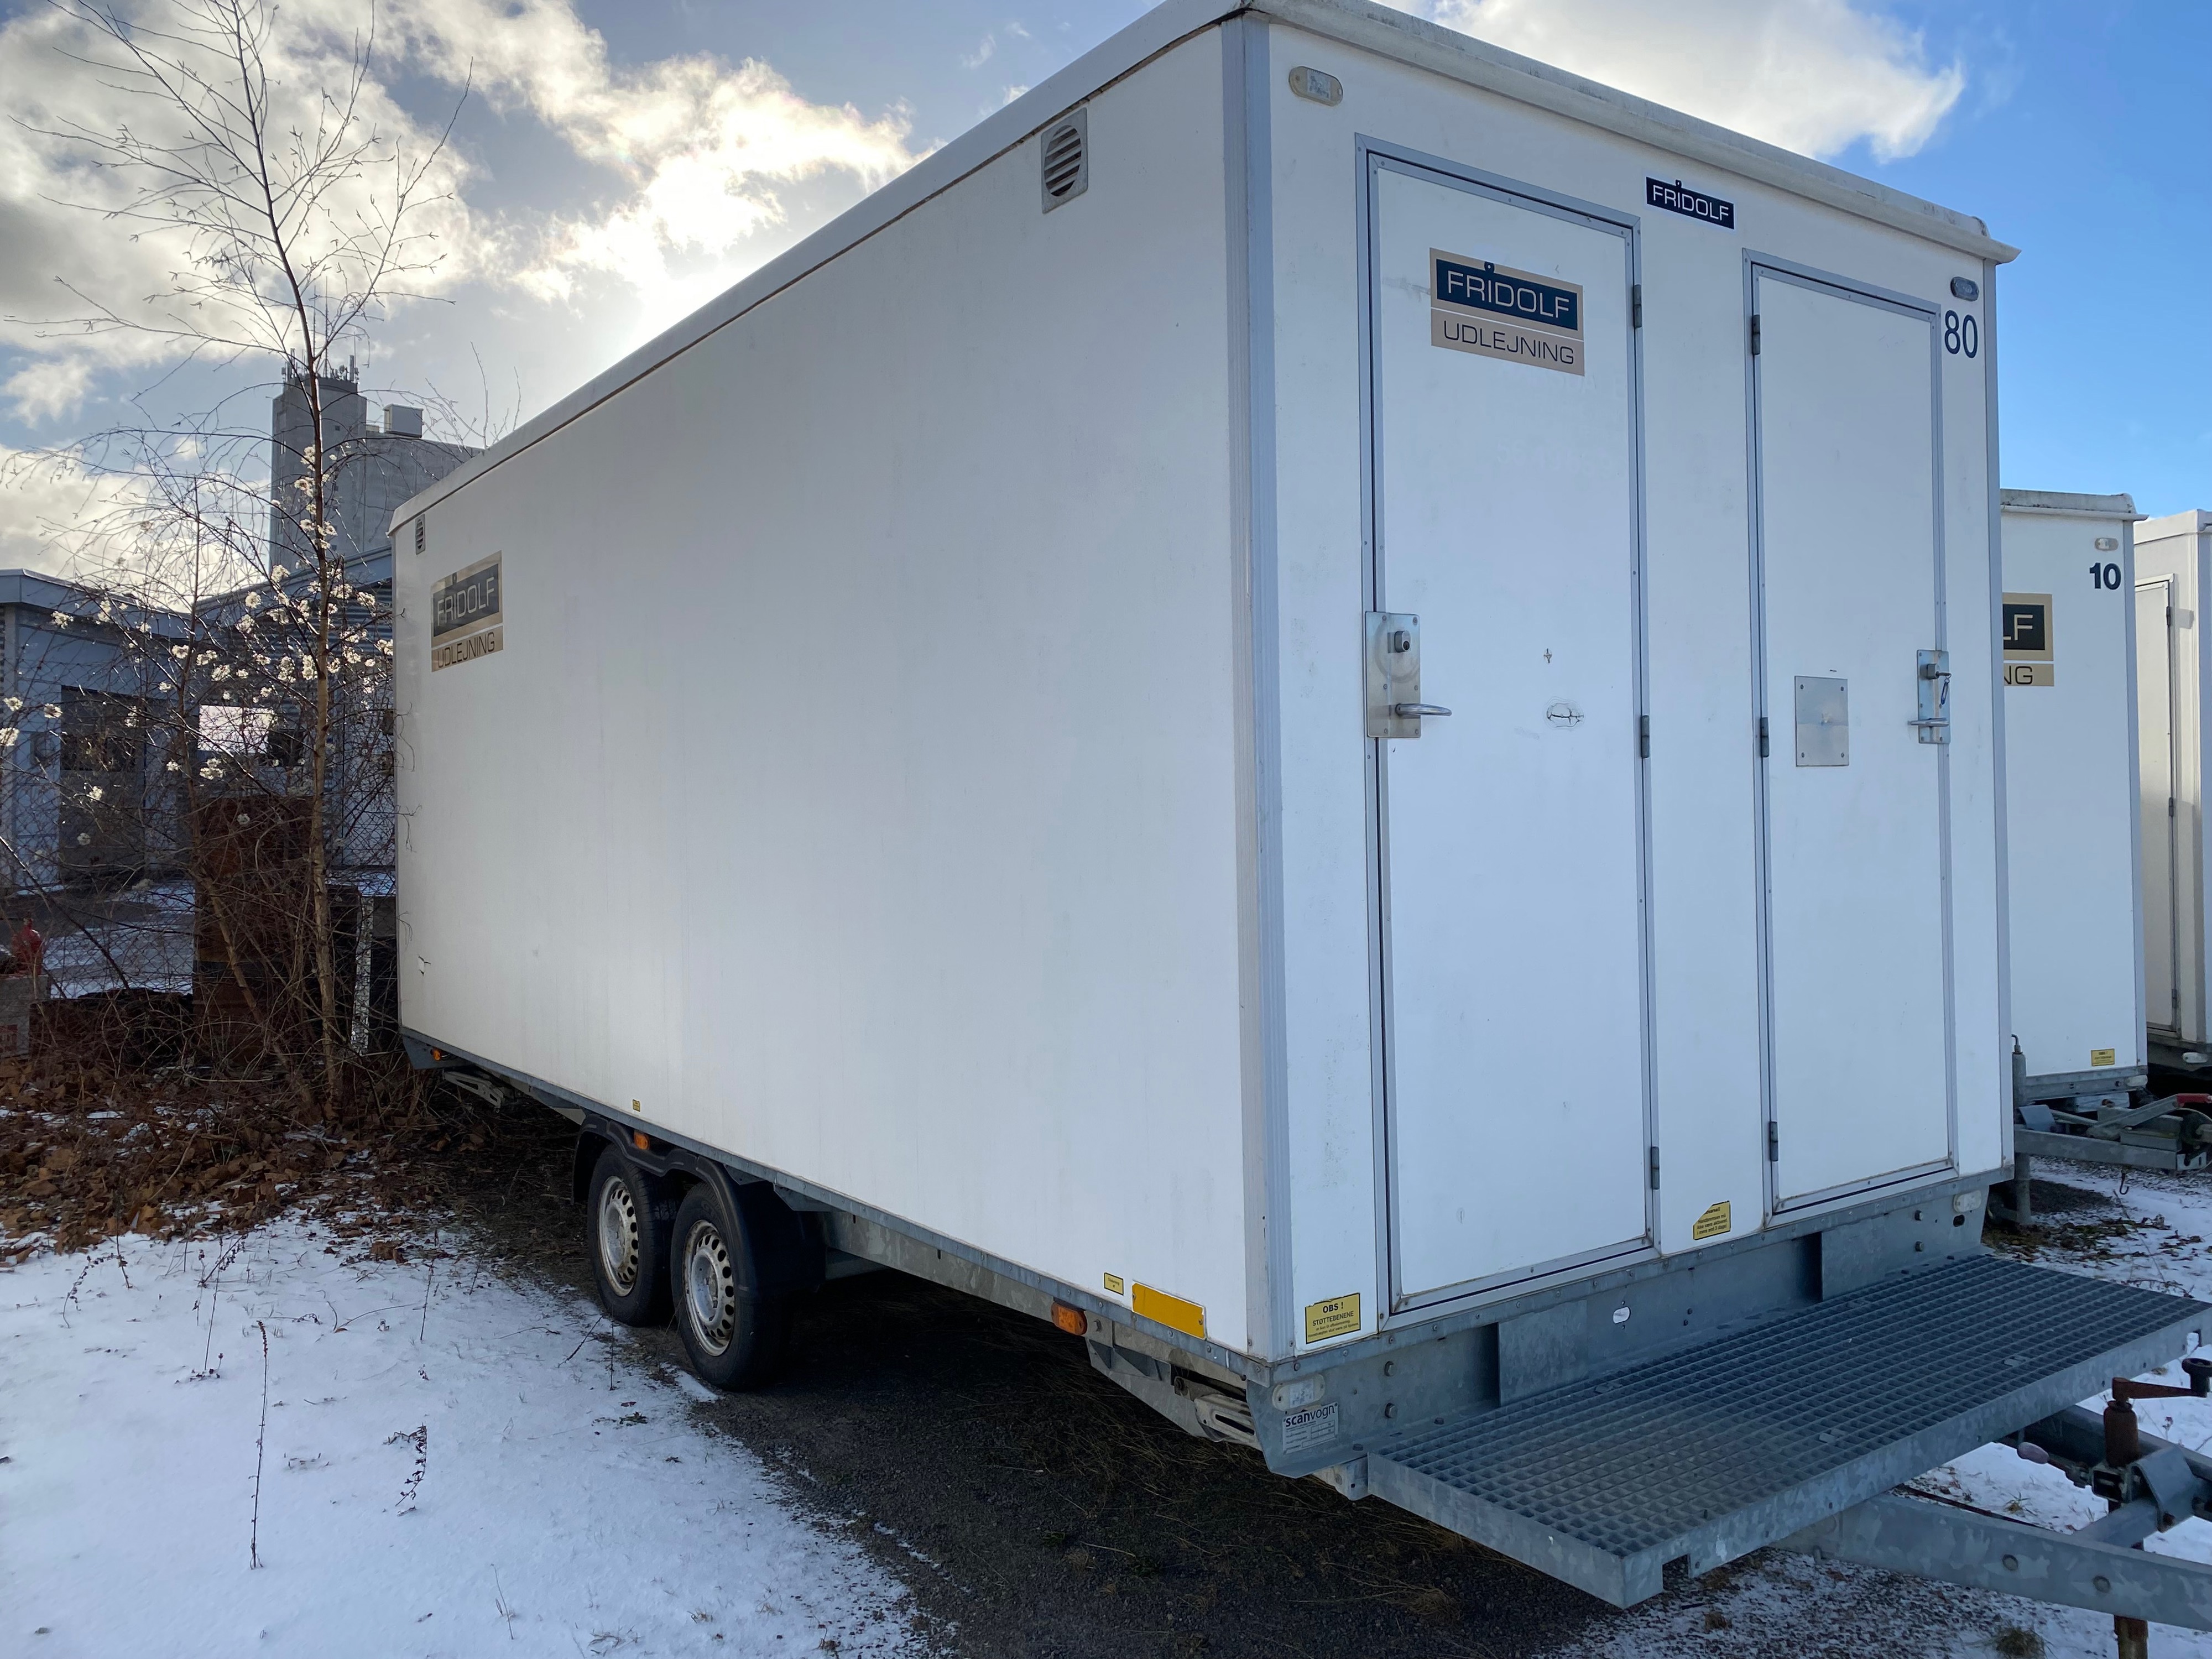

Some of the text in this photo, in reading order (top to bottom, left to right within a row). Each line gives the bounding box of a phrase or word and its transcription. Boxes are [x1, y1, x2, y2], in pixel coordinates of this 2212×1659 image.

[1653, 185, 1729, 221] FRIDOLF
[1447, 270, 1570, 319] FRIDOLF
[1444, 320, 1574, 364] UDLEJNING
[1944, 310, 1978, 358] 80
[2089, 562, 2122, 590] 10
[437, 576, 494, 627] FRIDOLF
[437, 632, 495, 669] UDLEJNING
[1322, 1303, 1338, 1313] OBS
[1285, 1405, 1335, 1427] scanvogn
